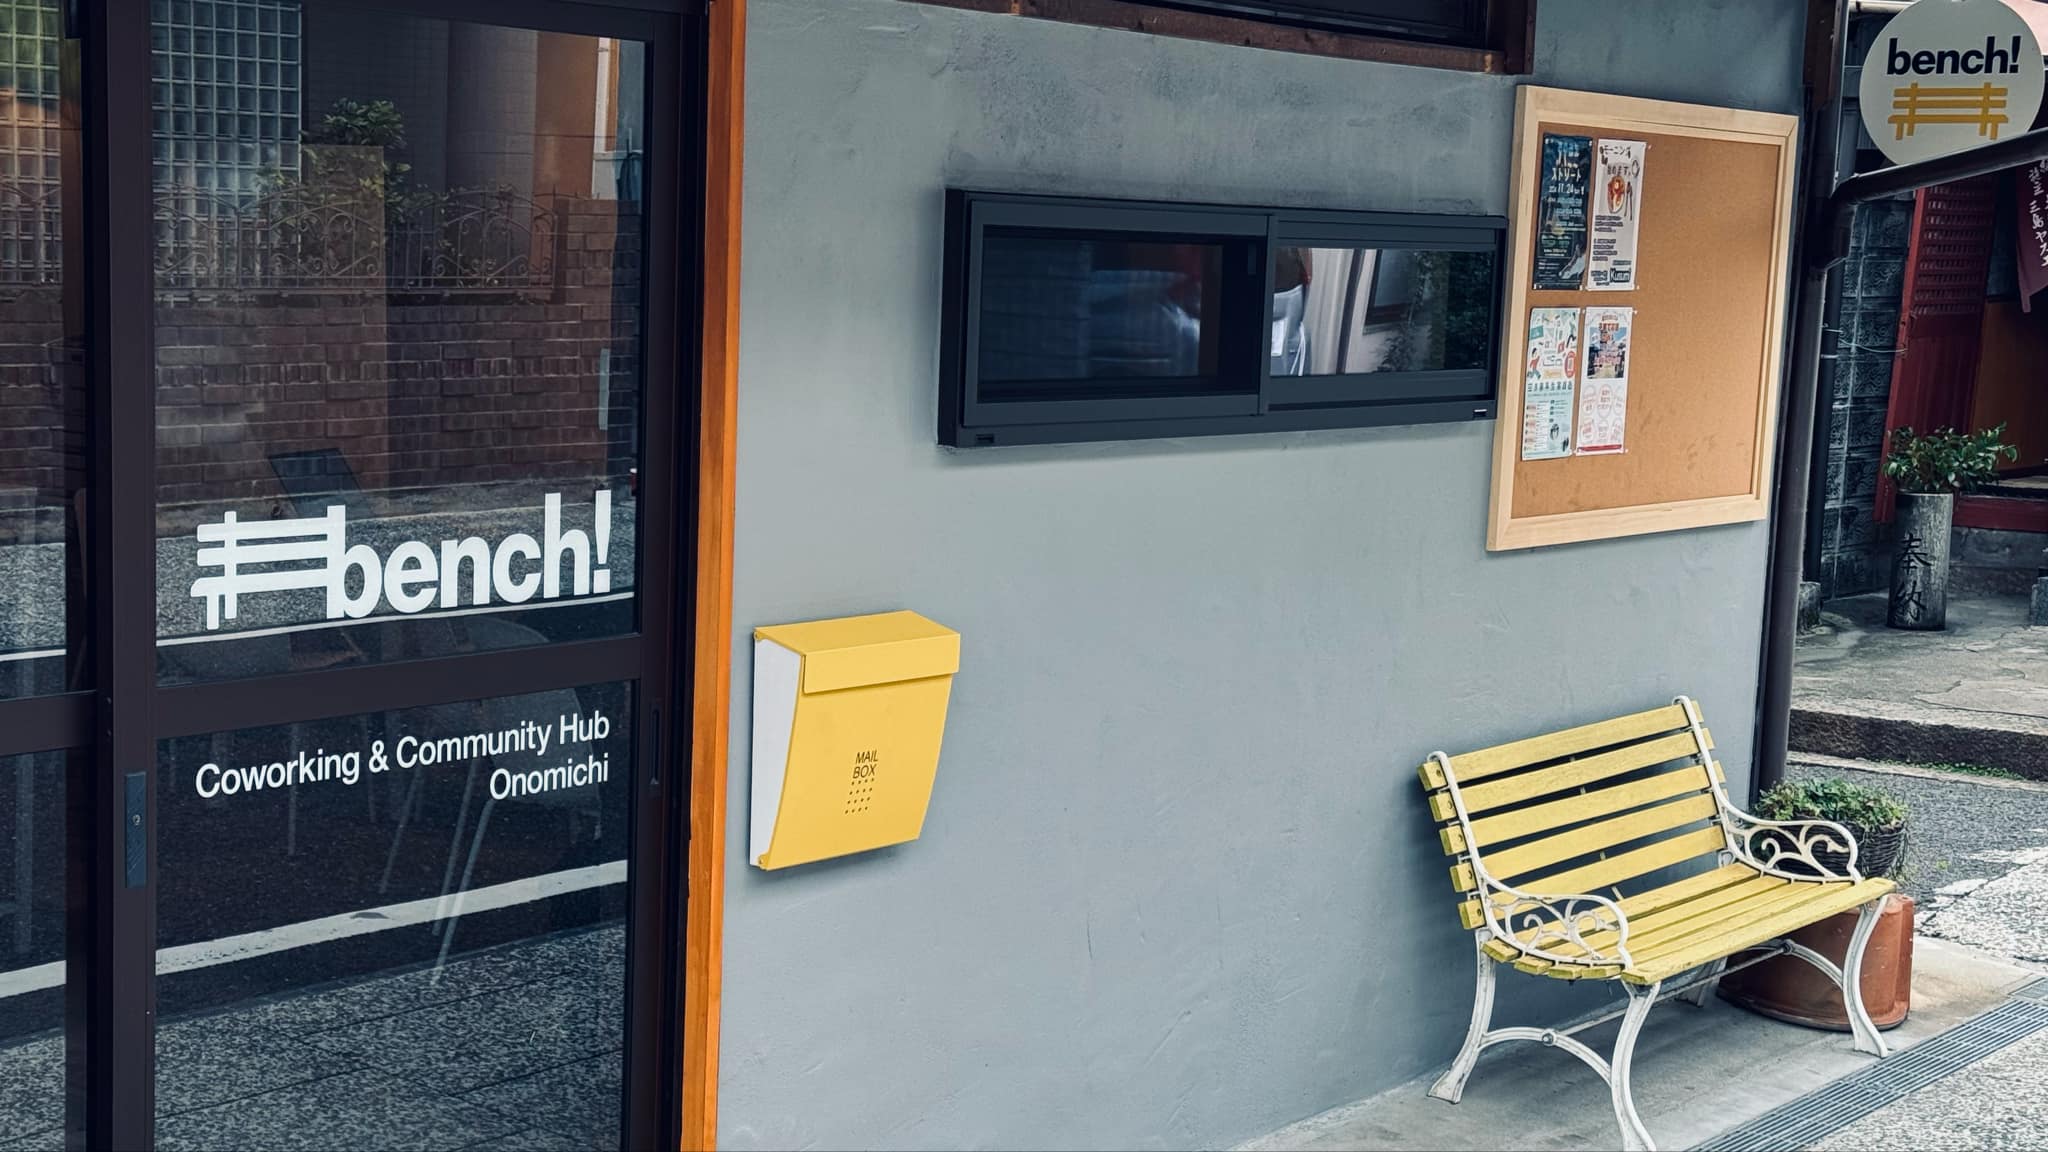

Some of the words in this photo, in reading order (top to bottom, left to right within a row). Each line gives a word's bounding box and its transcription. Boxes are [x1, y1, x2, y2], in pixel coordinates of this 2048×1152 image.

[1886, 35, 2022, 76] bench!
[1551, 167, 1582, 183] ストリート
[326, 489, 612, 619] bench!
[195, 751, 361, 798] Coworking
[368, 740, 390, 773] &
[396, 720, 553, 769] Community
[559, 710, 610, 745] Hub
[852, 764, 876, 778] BOX
[855, 749, 879, 764] MAIL
[489, 754, 610, 800] Onomichi
